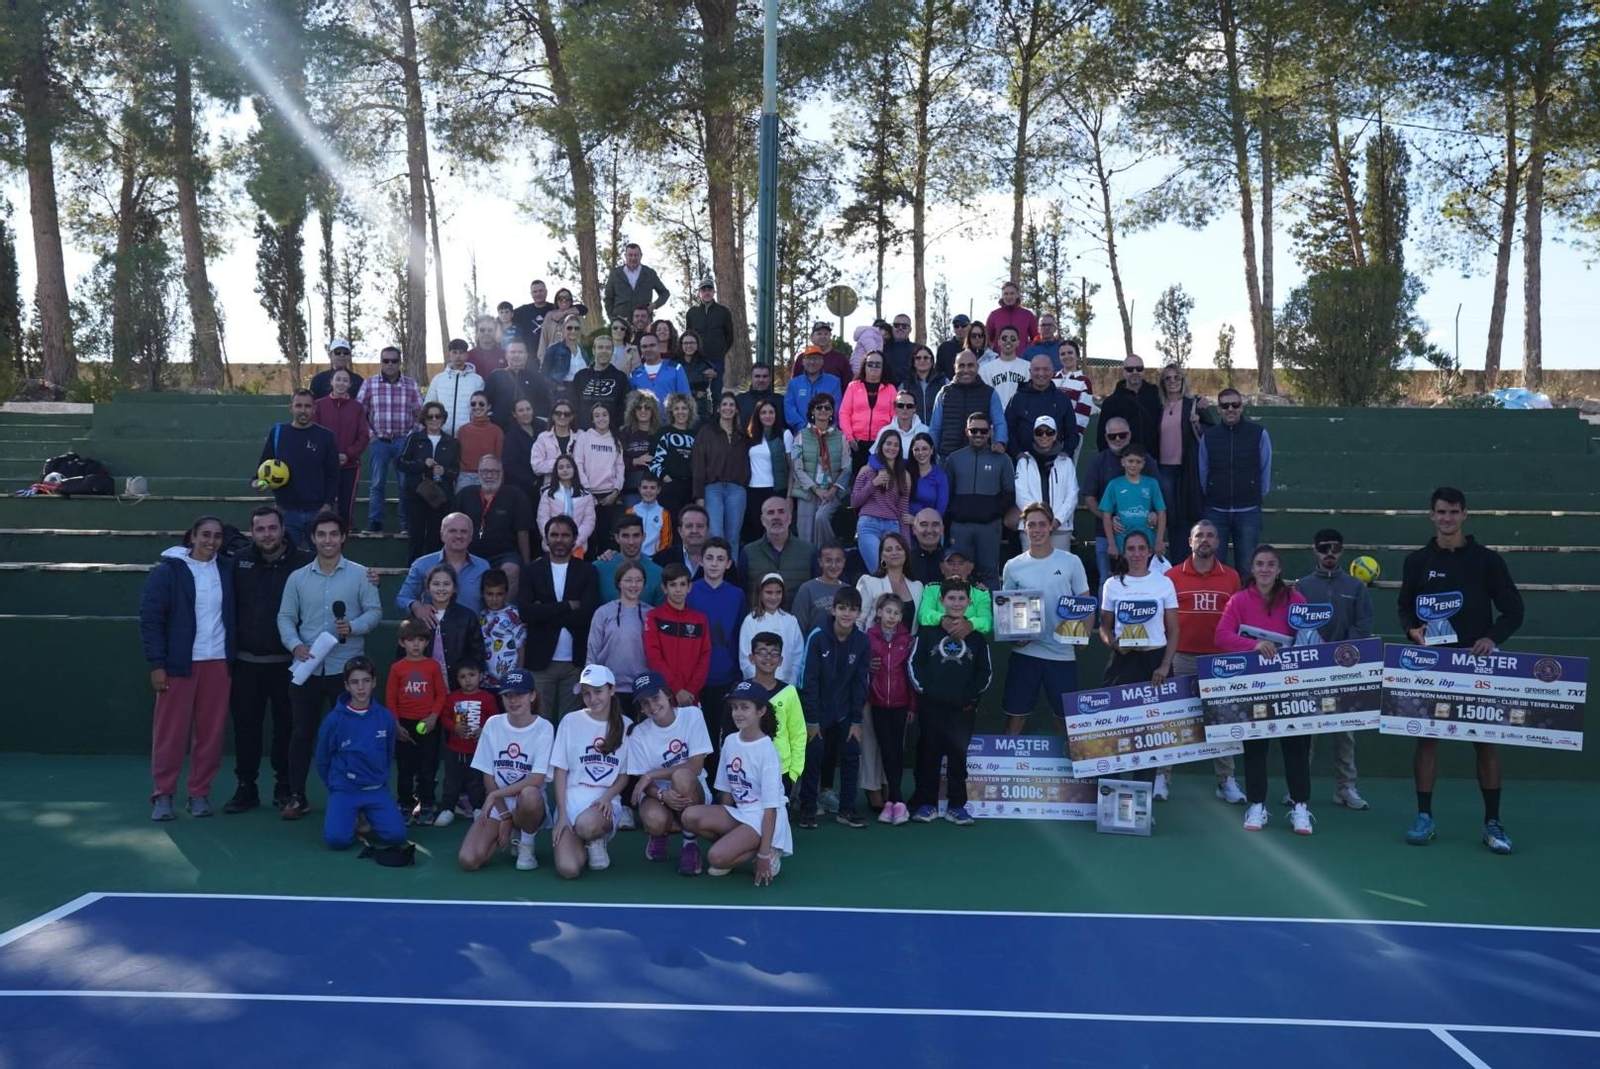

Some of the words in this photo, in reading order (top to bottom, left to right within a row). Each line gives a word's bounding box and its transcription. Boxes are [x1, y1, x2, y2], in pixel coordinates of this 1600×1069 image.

[992, 371, 1007, 386] NEW
[1060, 596, 1076, 606] ibp
[1072, 604, 1096, 612] TENIS
[1120, 602, 1134, 612] ibp
[1132, 606, 1156, 616] TENIS
[1420, 596, 1436, 608] ibp
[1434, 598, 1461, 610] TENIS
[1292, 605, 1308, 616] ibp
[1306, 611, 1331, 621] TENIS
[1214, 657, 1228, 666] ibp
[1225, 662, 1245, 670] TENIS
[1258, 649, 1319, 666] MASTER
[1404, 648, 1417, 658] ibp
[1414, 656, 1436, 666] TENIS
[1452, 653, 1518, 670] MASTER
[404, 681, 428, 693] ART
[1252, 680, 1266, 689] ibp
[1284, 676, 1300, 684] as
[1438, 678, 1454, 688] ibp
[1474, 680, 1491, 690] as
[1122, 682, 1178, 701] MASTER
[1208, 696, 1253, 706] SUBCAMPEONA
[1254, 693, 1279, 701] MASTER
[1360, 684, 1380, 692] ALBOX
[1390, 690, 1434, 700] SUBCAMPEÓN
[1436, 693, 1464, 702] MASTER
[1080, 696, 1092, 704] ibp
[1090, 698, 1109, 707] TENIS
[1272, 700, 1316, 716] 1.500€
[1116, 715, 1130, 724] ibp
[1146, 708, 1160, 718] as
[1456, 704, 1504, 722] 1.500€
[1069, 732, 1106, 742] CAMPEONA
[1107, 728, 1134, 737] MASTER
[1146, 723, 1164, 732] TENIS
[996, 738, 1050, 751] MASTER
[1134, 731, 1178, 750] 3.000€
[494, 760, 514, 769] YOUNG
[516, 760, 532, 771] TOUR
[579, 754, 602, 763] YOUNG
[602, 754, 619, 766] TOUR
[986, 762, 1000, 772] ibp
[1016, 762, 1030, 770] as
[1002, 785, 1044, 798] 3.000€
